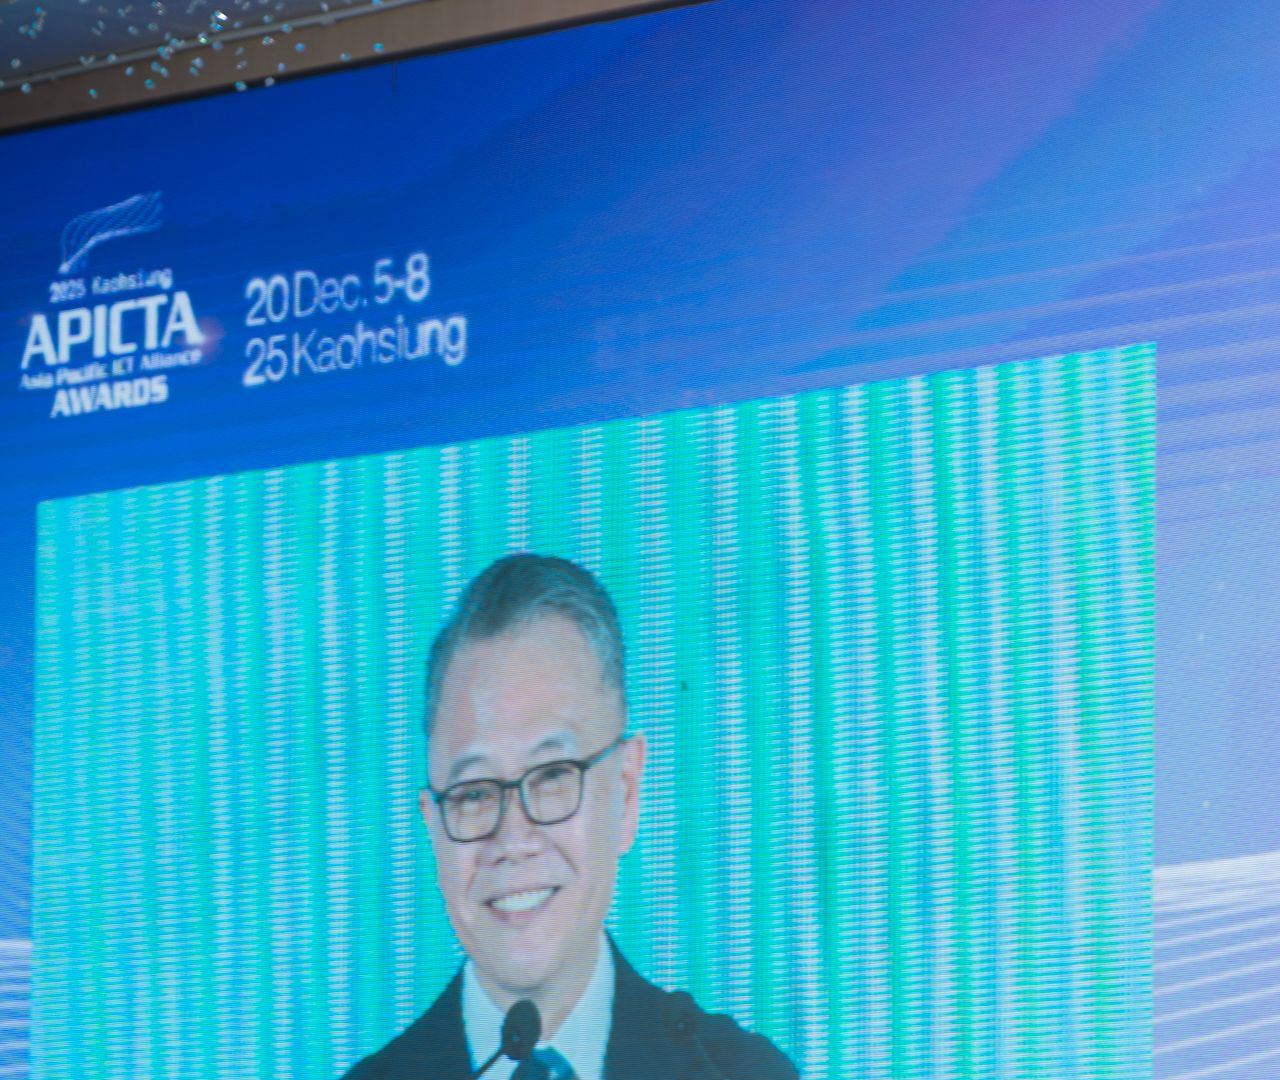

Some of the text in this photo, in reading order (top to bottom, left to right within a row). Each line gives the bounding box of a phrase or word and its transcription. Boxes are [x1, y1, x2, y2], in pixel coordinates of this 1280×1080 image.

[245, 252, 431, 326] 20 Dec. 5-8
[20, 291, 206, 370] APICTA
[242, 314, 467, 387] 25 Kaohsiung
[50, 375, 169, 418] AWARDS
